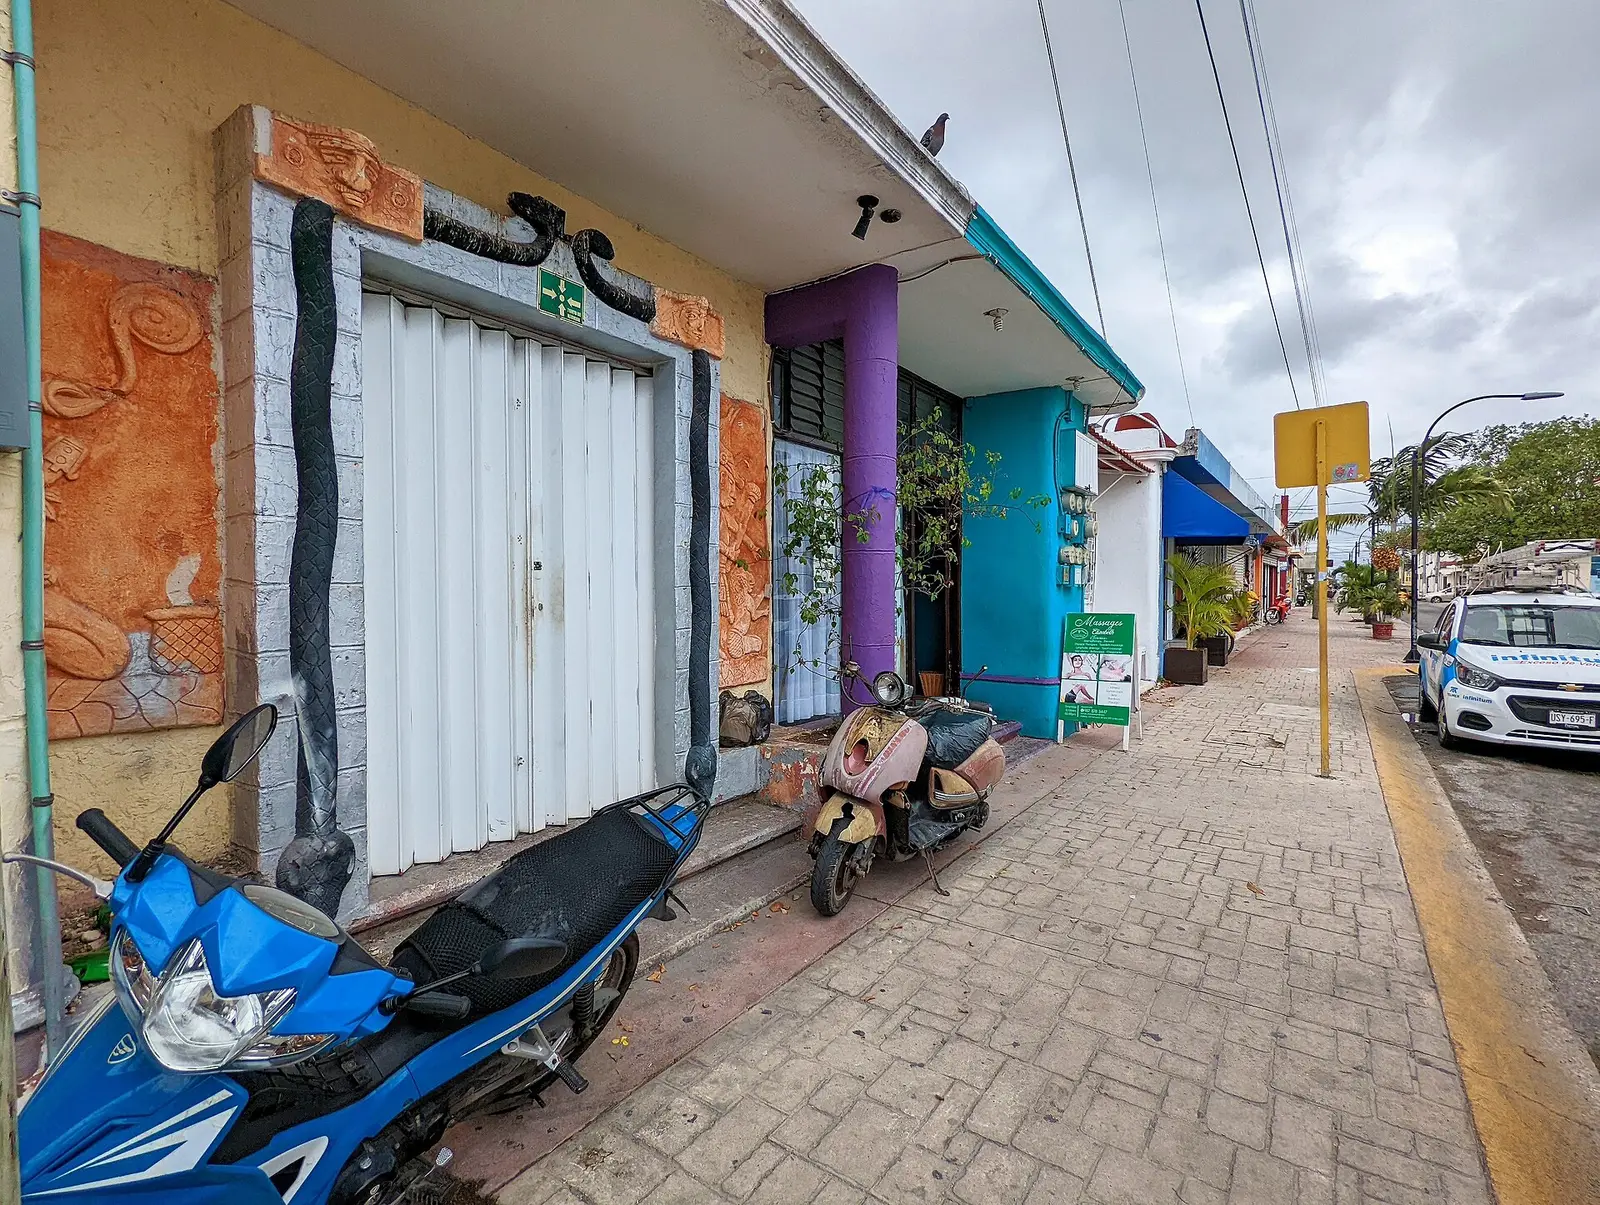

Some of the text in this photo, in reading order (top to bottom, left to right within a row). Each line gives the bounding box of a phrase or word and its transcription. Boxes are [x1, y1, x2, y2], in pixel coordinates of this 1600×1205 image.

[1075, 616, 1123, 630] Massages
[1463, 695, 1492, 704] infinitum
[1551, 714, 1594, 724] USY-695-F
